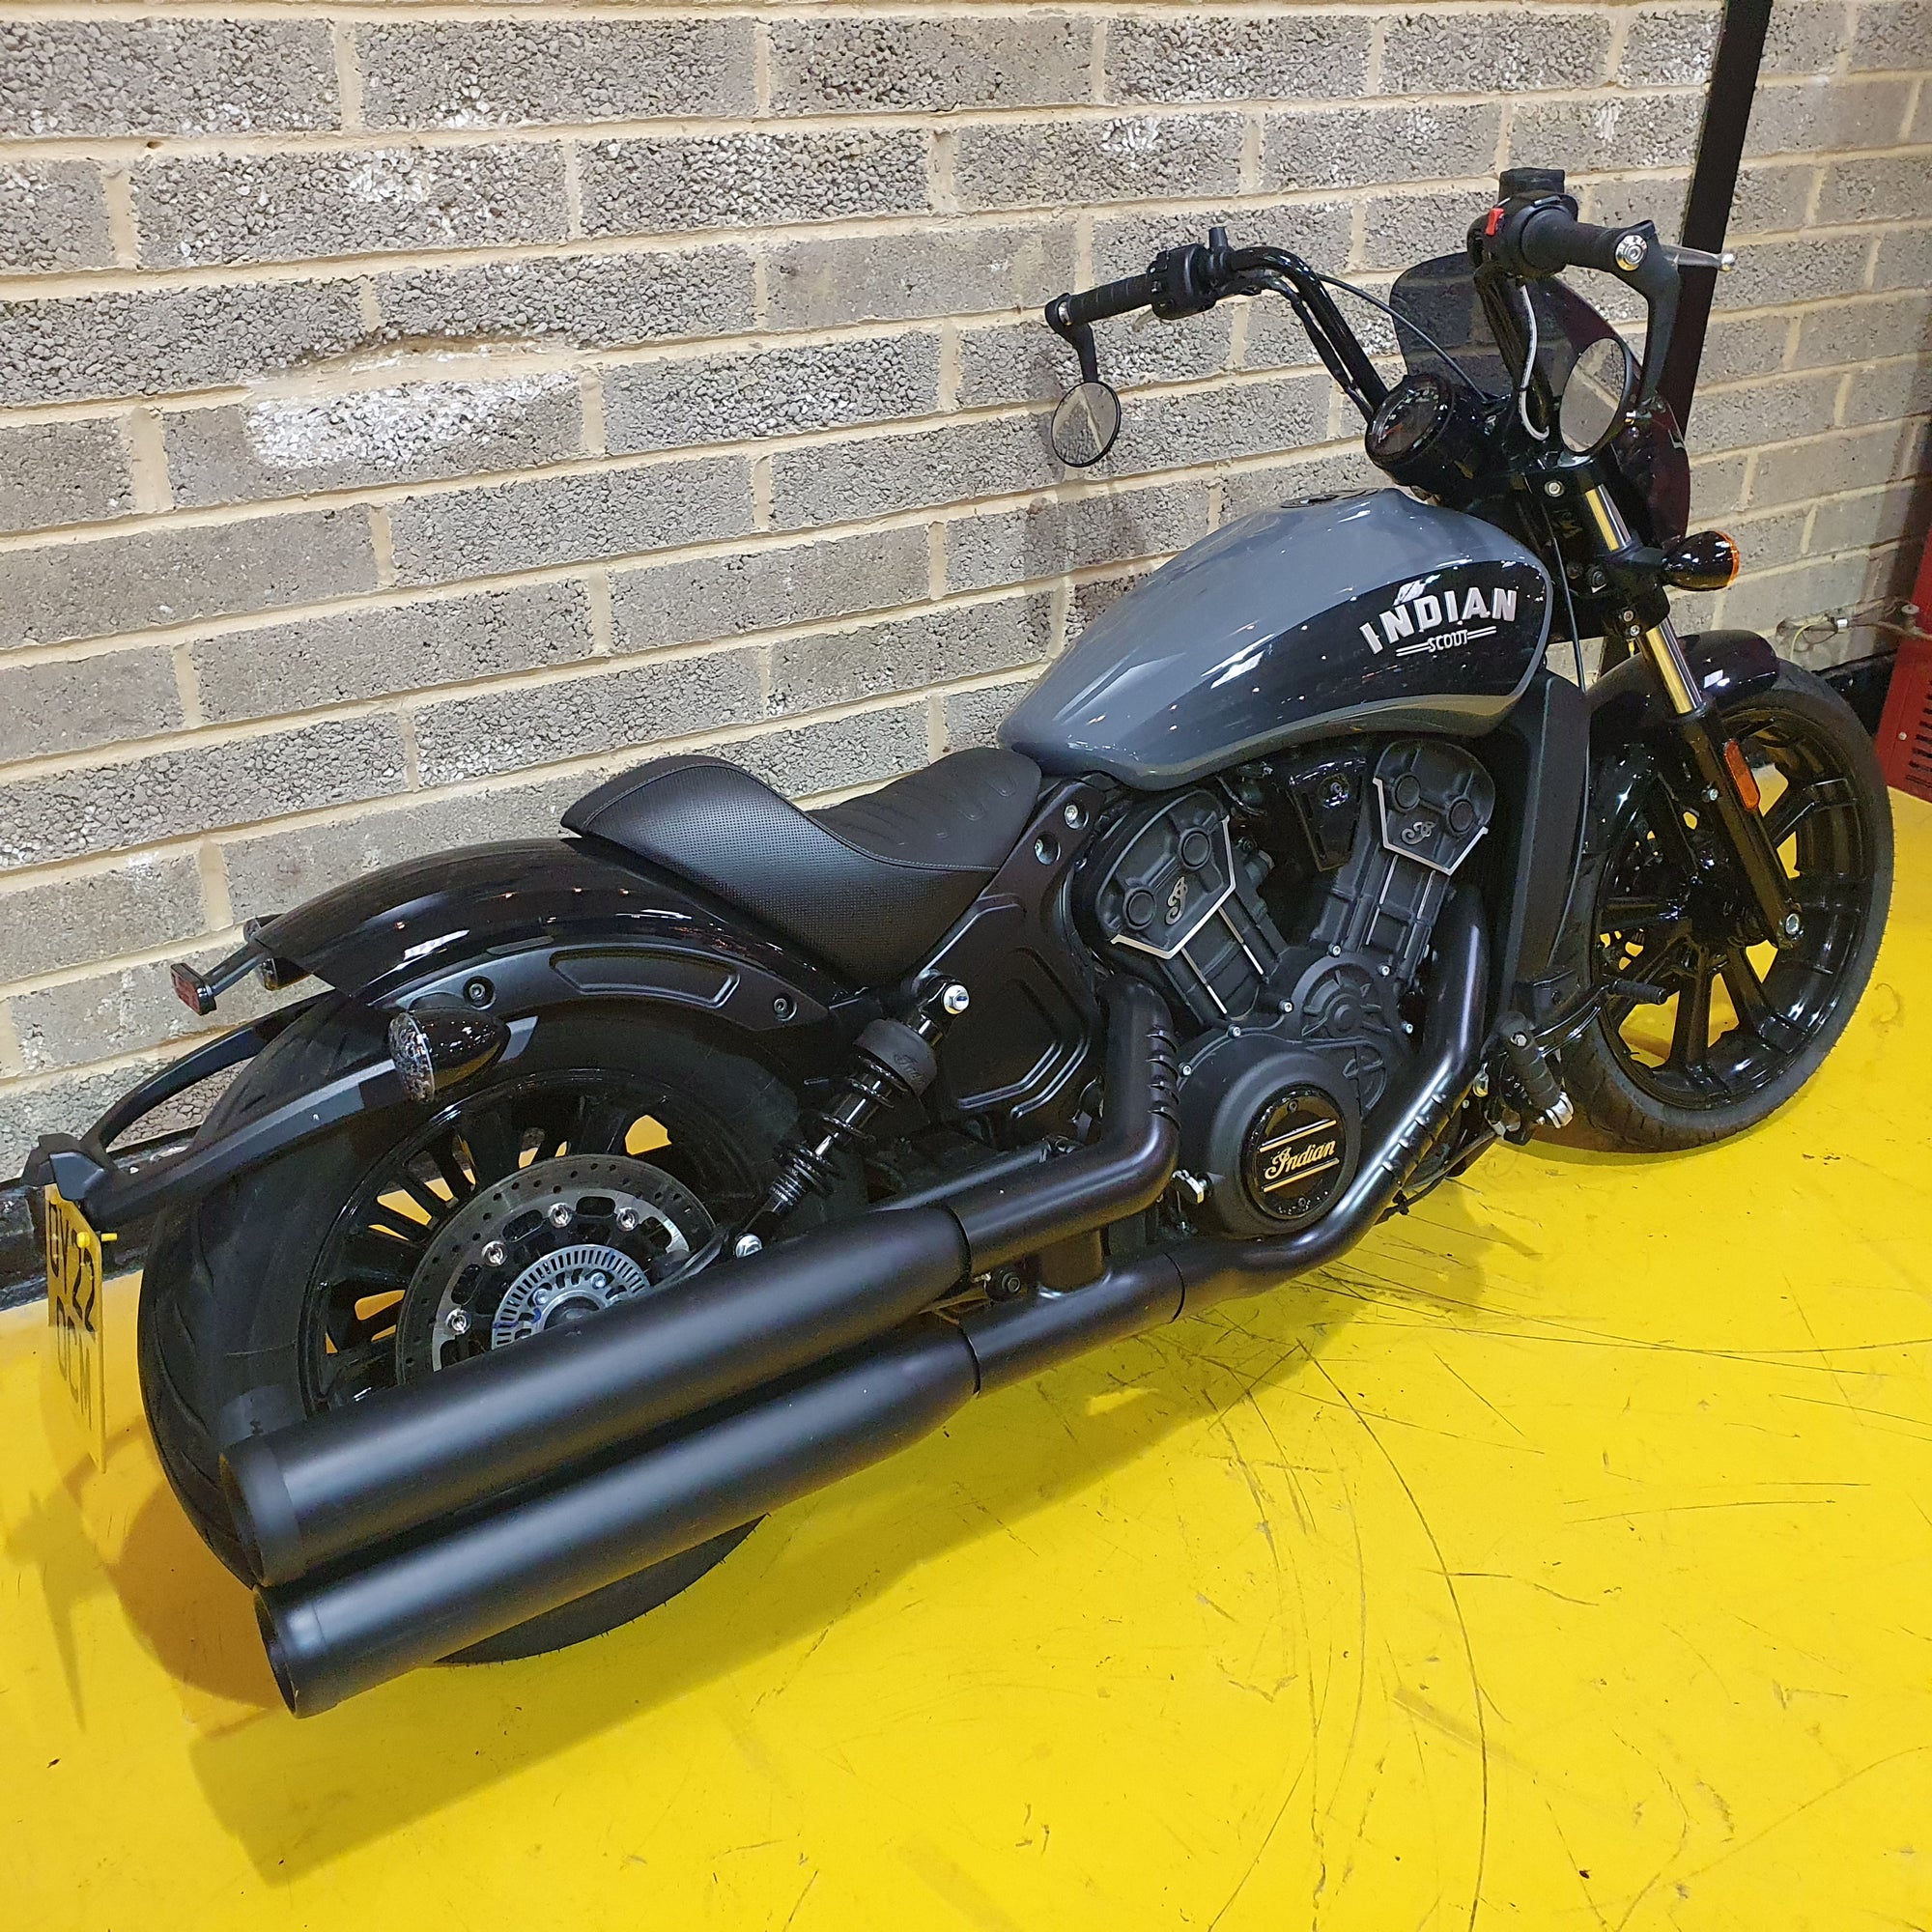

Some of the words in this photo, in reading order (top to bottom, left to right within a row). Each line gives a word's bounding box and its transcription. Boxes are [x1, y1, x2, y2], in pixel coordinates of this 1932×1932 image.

[1359, 587, 1517, 655] INDIAN
[1428, 630, 1468, 652] SCOUT
[1264, 1140, 1336, 1179] Indian
